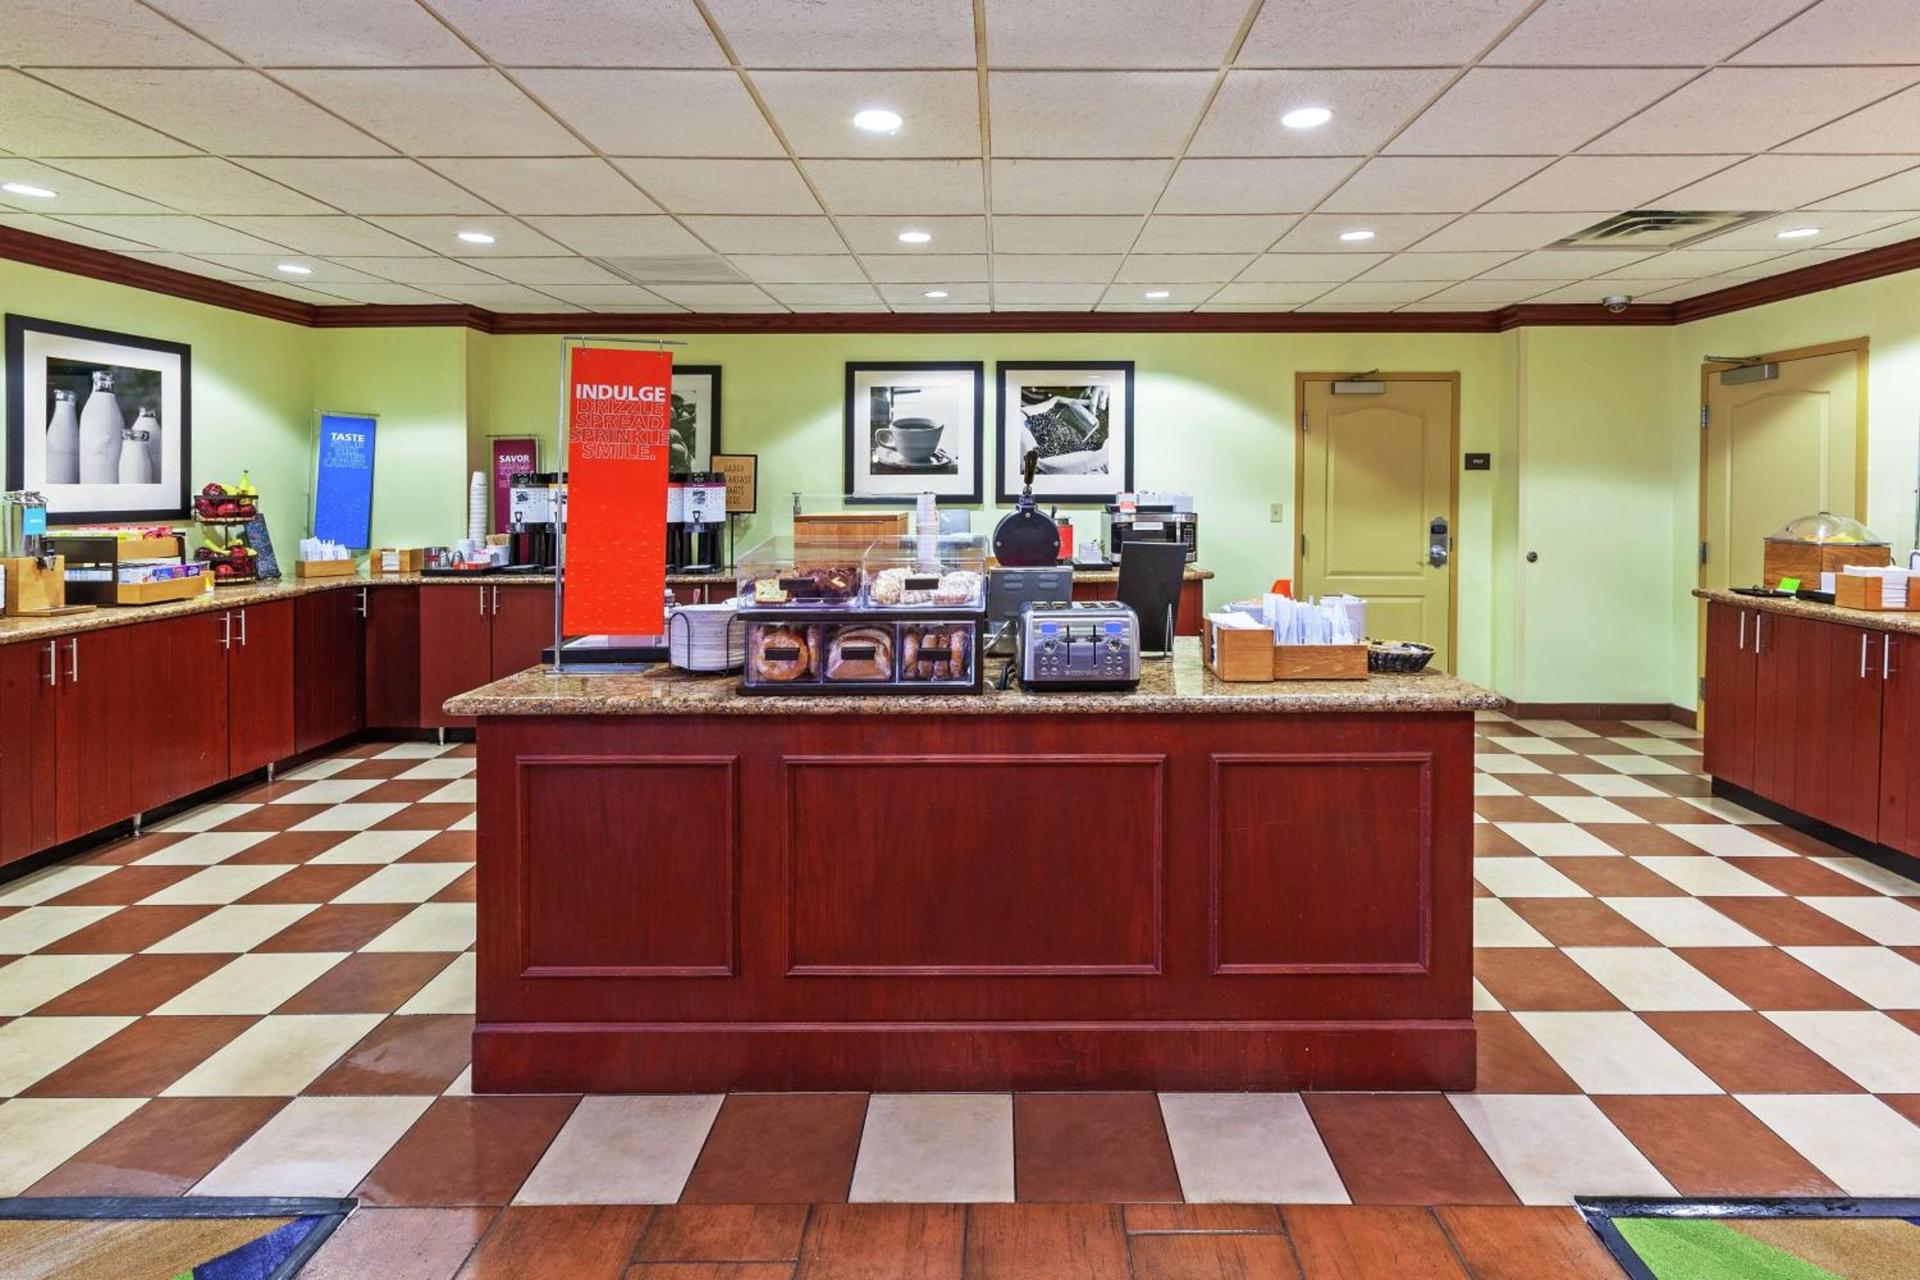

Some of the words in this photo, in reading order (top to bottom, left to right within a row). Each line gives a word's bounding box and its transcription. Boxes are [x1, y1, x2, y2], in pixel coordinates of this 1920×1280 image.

[576, 383, 666, 403] INDULGE
[577, 400, 664, 416] DRIZZLE
[576, 414, 664, 430] SPREAD
[330, 431, 365, 443] TASTE
[568, 428, 669, 446] SPRINKLE
[499, 454, 530, 463] SAVOR
[582, 443, 656, 460] SMILE.
